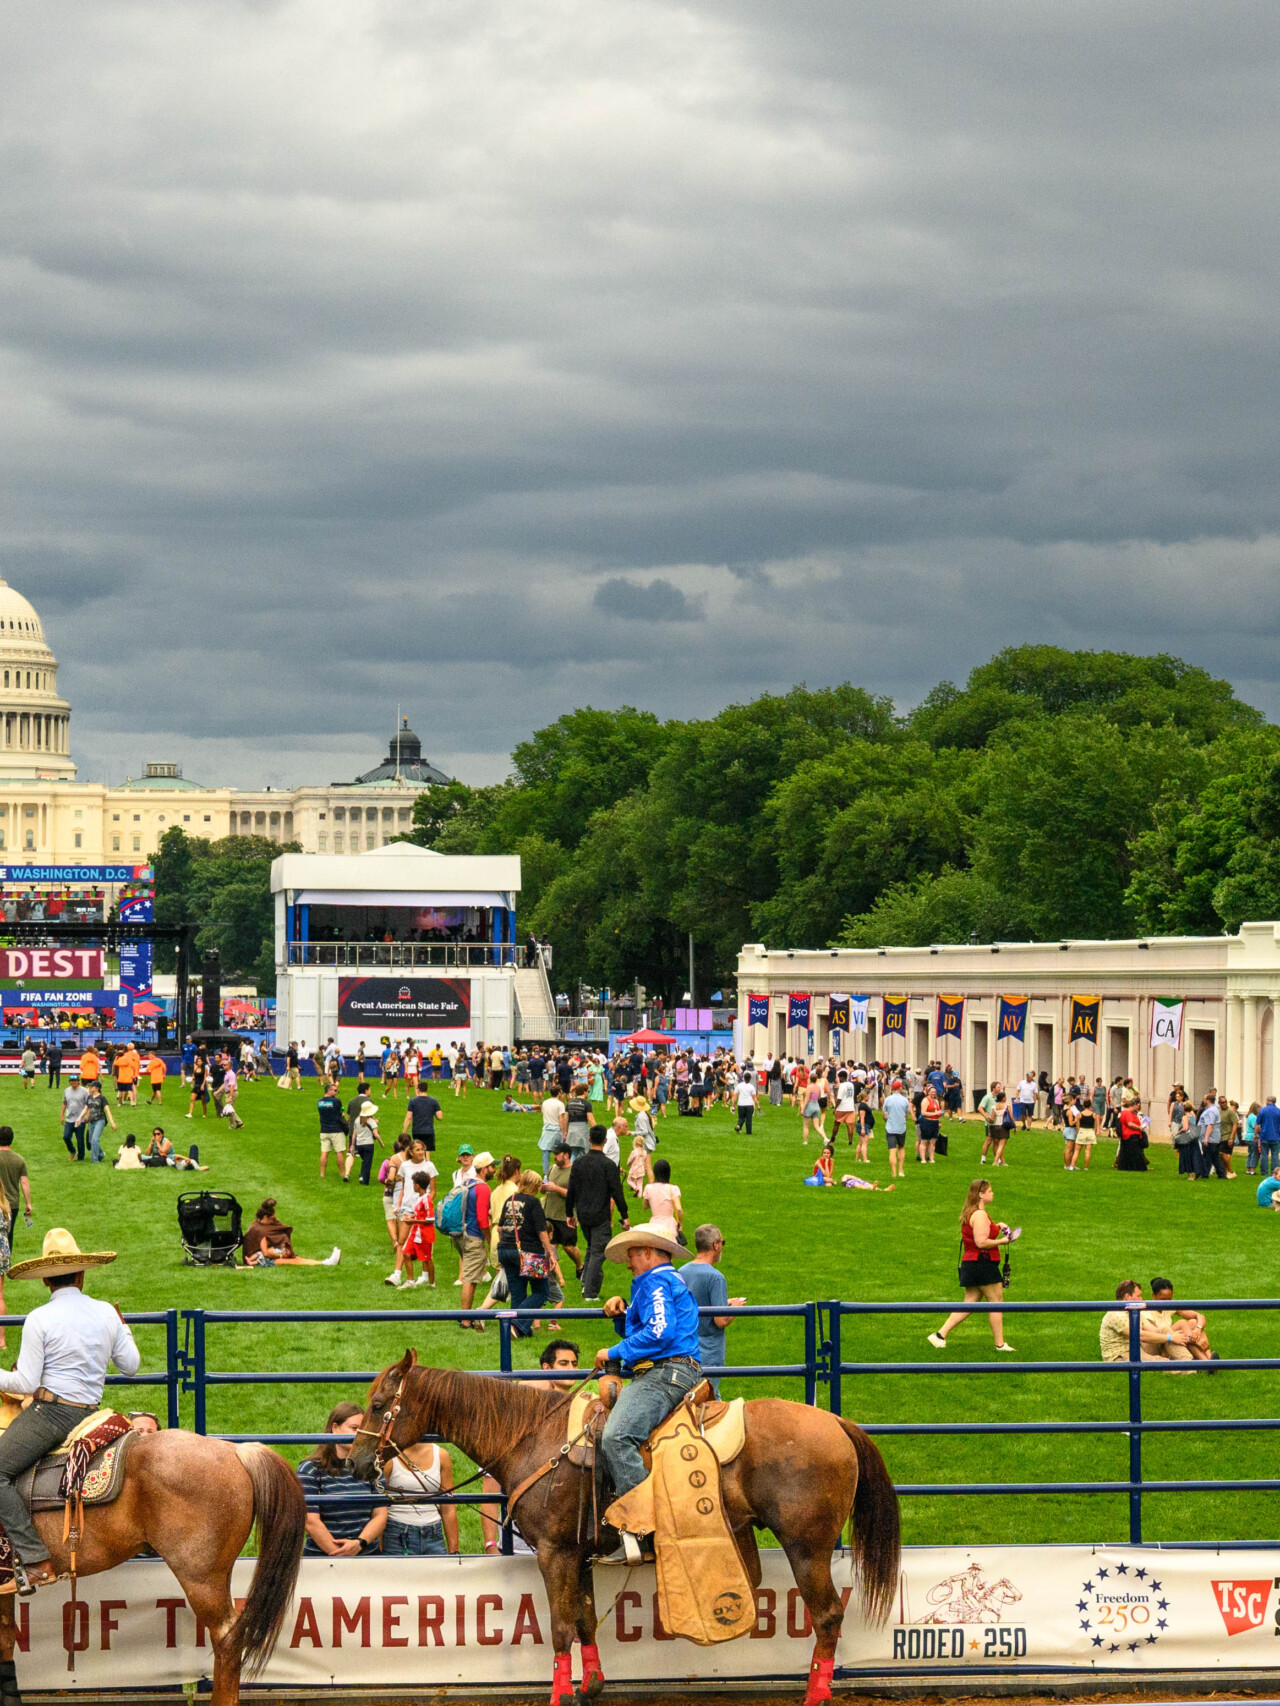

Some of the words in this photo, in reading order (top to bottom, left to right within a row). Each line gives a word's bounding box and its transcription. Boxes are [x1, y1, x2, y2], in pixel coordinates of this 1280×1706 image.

[11, 868, 103, 881] WASHINGTON,
[105, 868, 130, 879] D.C.
[20, 993, 40, 1002] FIFA
[44, 993, 64, 1002] FAN
[66, 993, 93, 1002] ZONE
[350, 1001, 374, 1009] Great
[376, 1001, 417, 1010] American
[418, 1001, 439, 1010] State
[441, 1002, 459, 1010] Fair
[751, 1007, 767, 1018] 250
[790, 1008, 808, 1020] 250
[832, 1010, 846, 1025] AS
[853, 1011, 864, 1025] VI
[886, 1013, 902, 1029] GU
[943, 1013, 956, 1030] ID
[1002, 1014, 1021, 1032] NV
[1074, 1015, 1094, 1034] AK
[1155, 1018, 1175, 1038] CA
[650, 1286, 667, 1339] Wrangler
[1095, 1593, 1149, 1603] Freedom
[1218, 1582, 1262, 1624] TSC
[62, 1599, 128, 1652] OF
[289, 1593, 581, 1649] AMERICA
[1097, 1604, 1150, 1633] 250
[892, 1628, 964, 1660] RODEO
[984, 1628, 1027, 1658] 250
